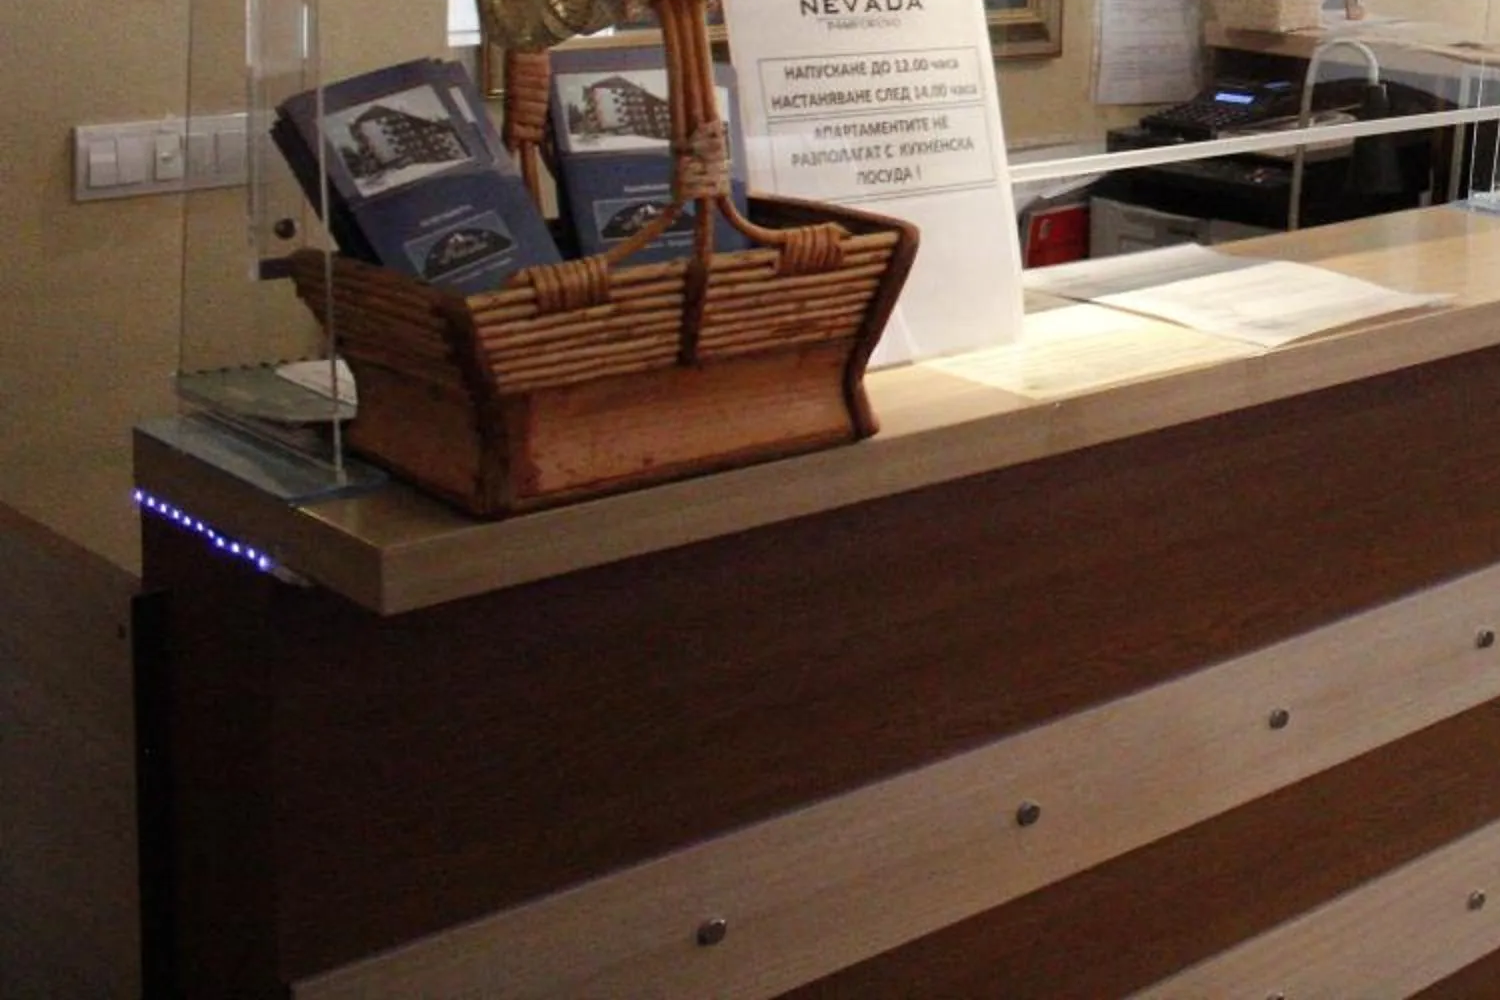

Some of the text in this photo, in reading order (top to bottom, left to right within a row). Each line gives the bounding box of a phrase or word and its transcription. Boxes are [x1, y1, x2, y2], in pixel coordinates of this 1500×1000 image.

[783, 61, 867, 80] НАПУСКАНЕ
[871, 60, 890, 77] ДО
[875, 86, 911, 103] СЛЕД
